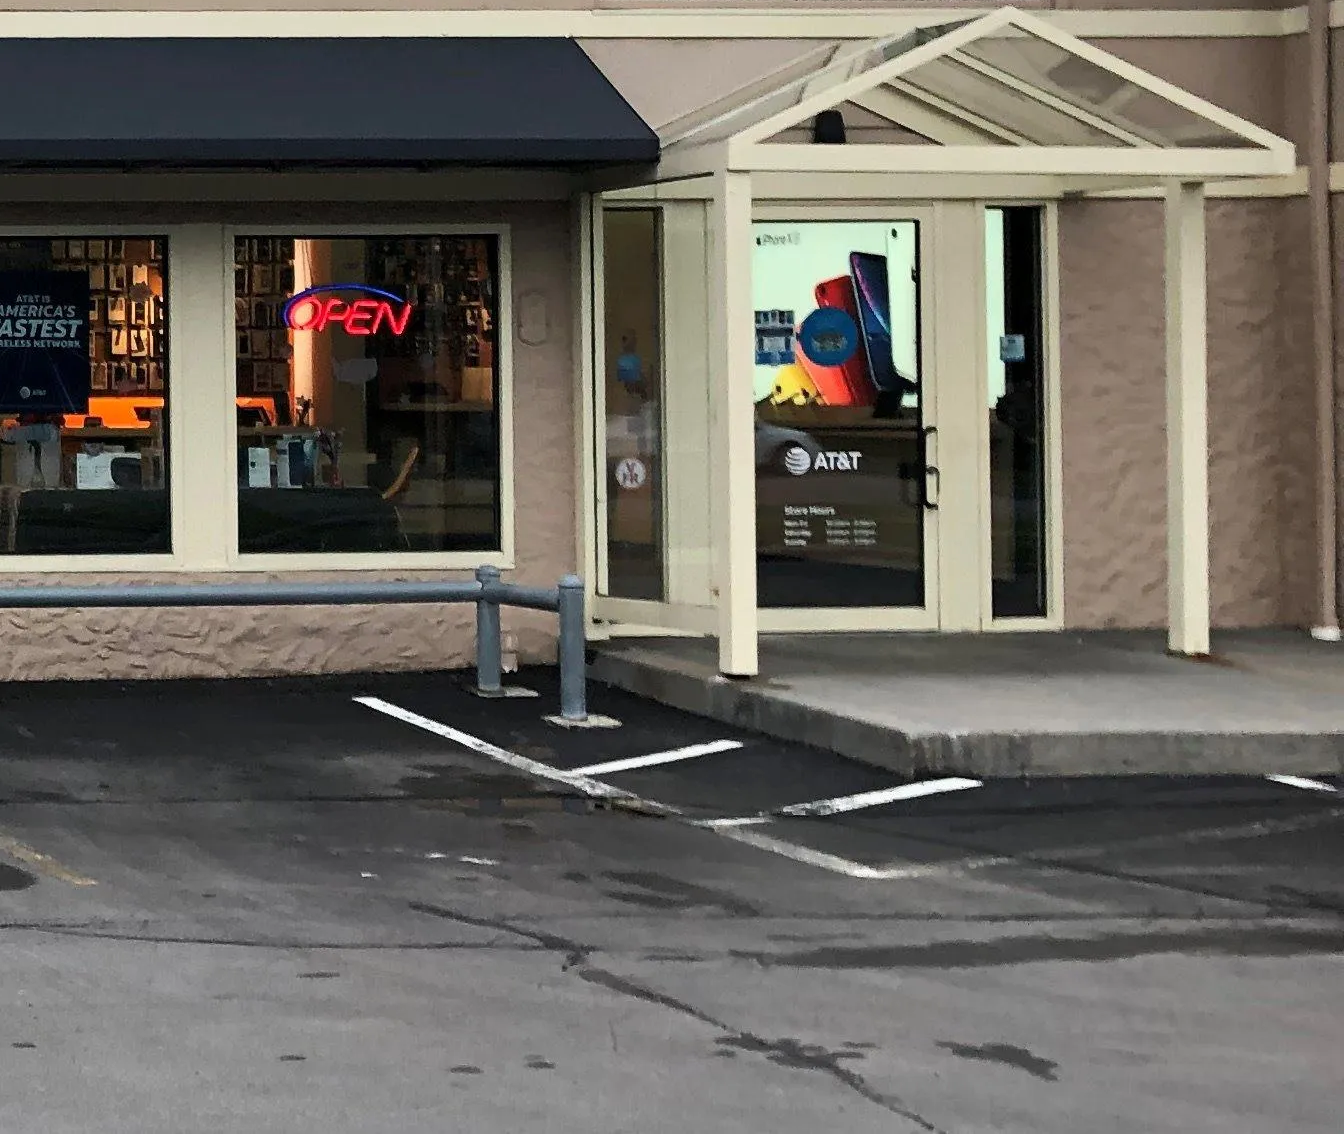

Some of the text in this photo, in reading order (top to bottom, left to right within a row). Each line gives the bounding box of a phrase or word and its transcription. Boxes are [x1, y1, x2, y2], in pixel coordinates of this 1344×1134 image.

[288, 294, 412, 335] OPEN
[33, 339, 80, 348] NETWORK
[813, 450, 863, 471] AT&T
